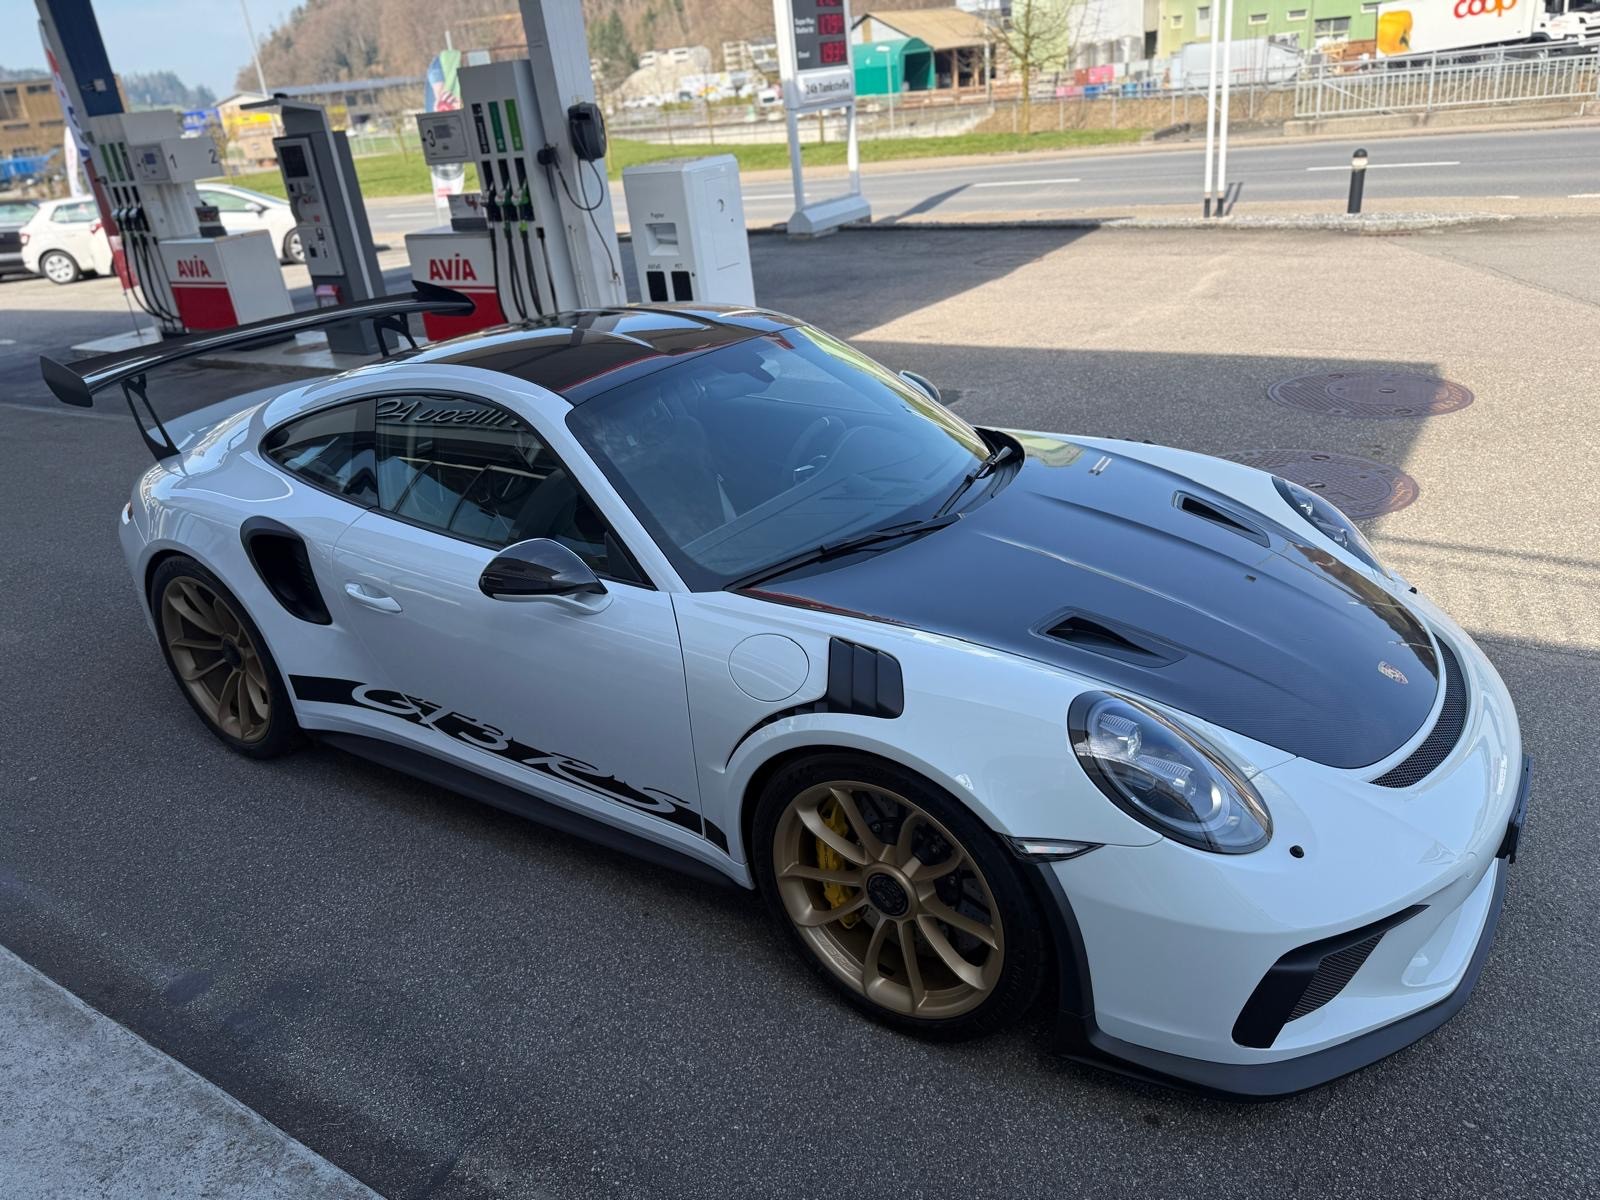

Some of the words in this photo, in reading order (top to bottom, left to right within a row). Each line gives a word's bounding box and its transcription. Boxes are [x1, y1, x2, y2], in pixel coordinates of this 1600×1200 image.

[427, 129, 436, 148] 3
[169, 154, 178, 169] 1
[208, 149, 219, 165] 2
[177, 255, 212, 278] AVIA
[430, 253, 478, 281] AVIA
[352, 683, 511, 752] GT3
